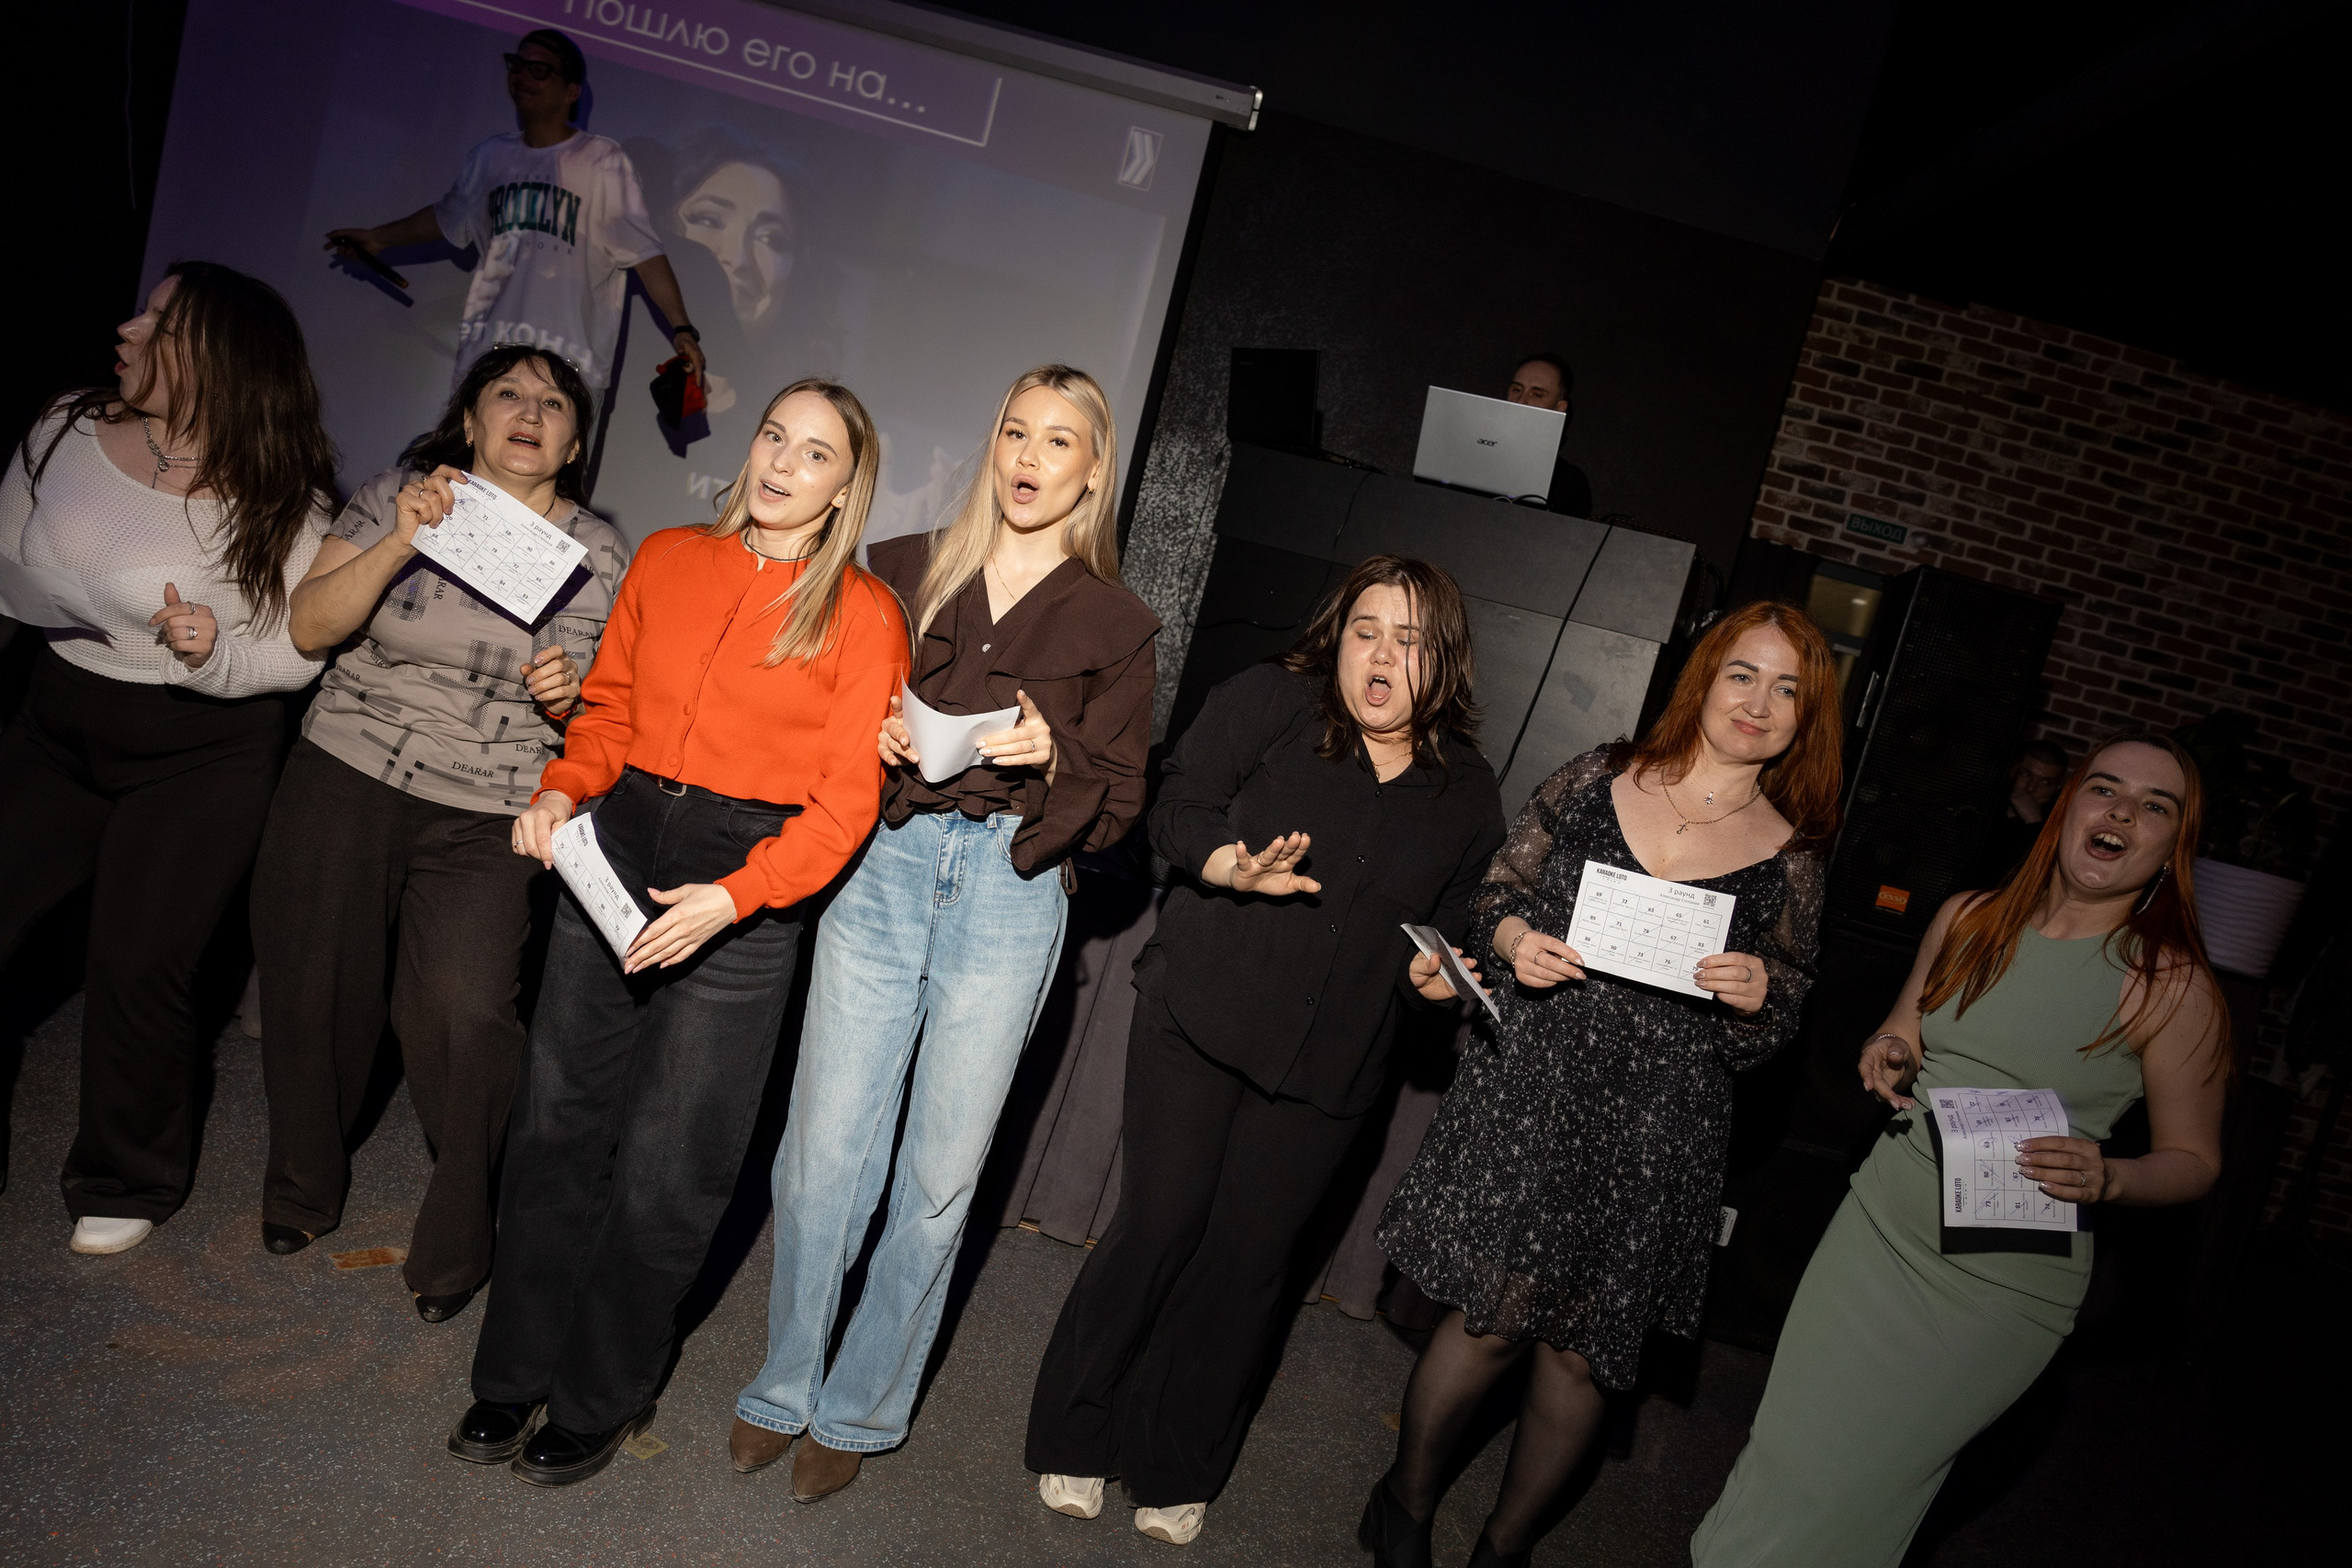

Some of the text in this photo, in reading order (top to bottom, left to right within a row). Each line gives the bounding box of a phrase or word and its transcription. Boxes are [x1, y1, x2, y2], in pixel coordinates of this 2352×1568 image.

[743, 39, 817, 80] его
[829, 61, 926, 113] на...
[1476, 437, 1498, 447] acer
[468, 479, 497, 501] KARAOKE LOTO
[535, 525, 552, 540] раунд
[1850, 516, 1904, 542] ВЫХОД
[451, 761, 494, 778] DEARAR
[1597, 868, 1616, 878] KARAOKE
[1616, 873, 1627, 881] LOTO
[1659, 893, 1680, 902] Александр
[1674, 888, 1695, 899] раунд
[1948, 1114, 1958, 1128] раунд
